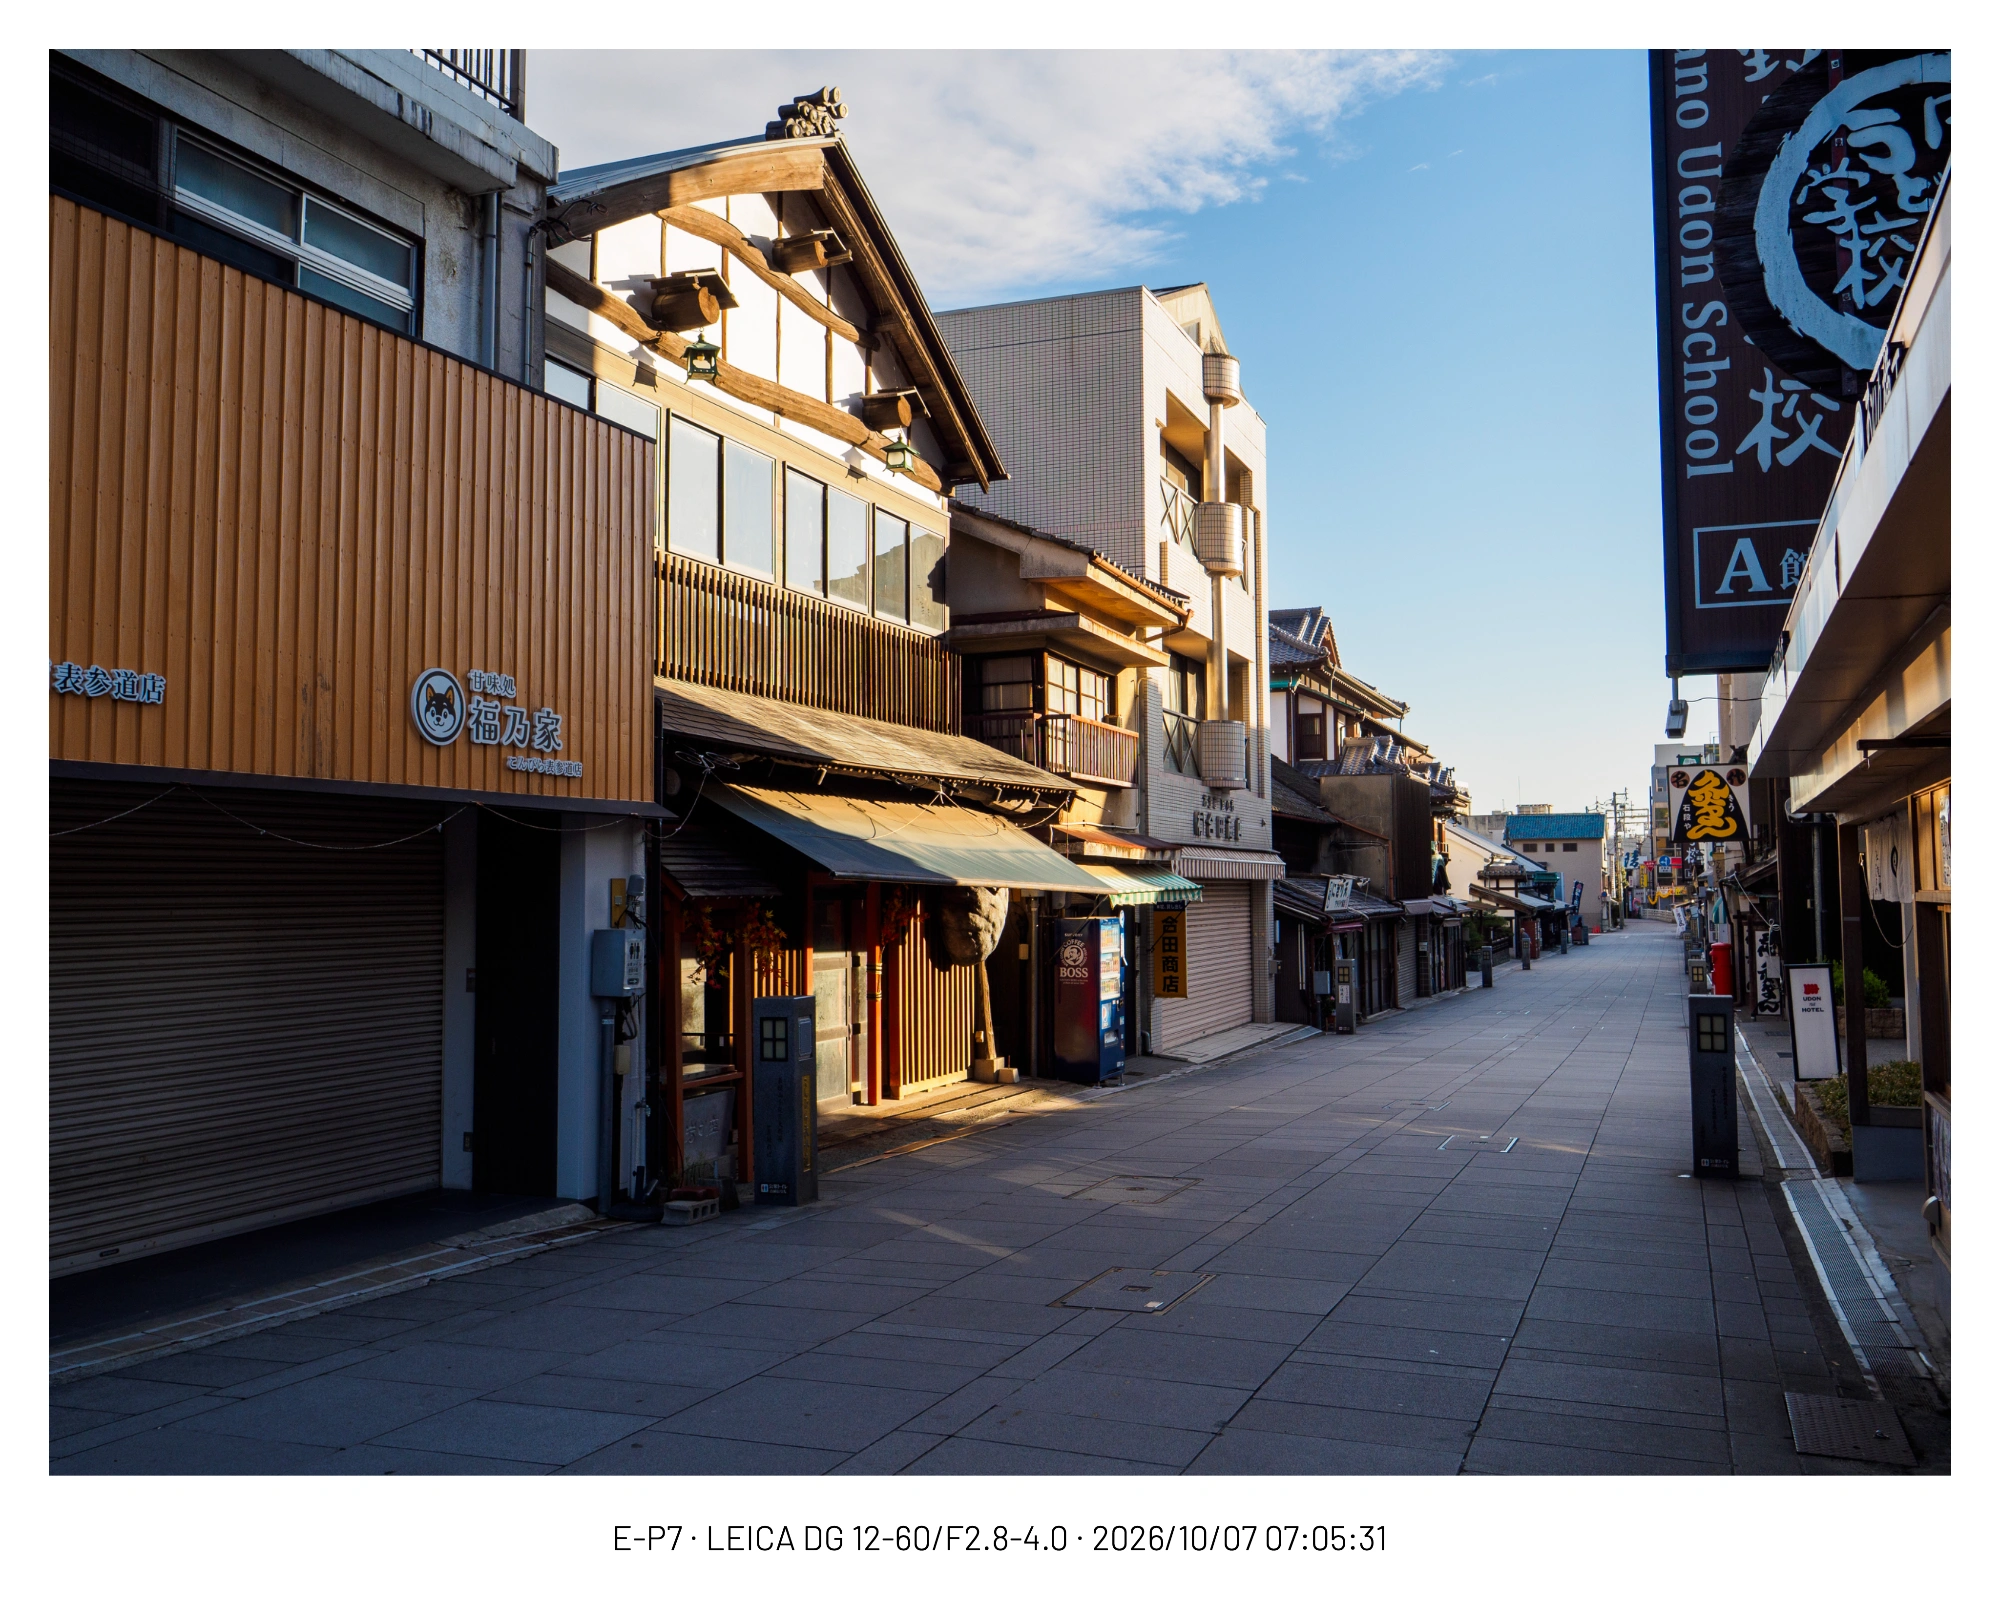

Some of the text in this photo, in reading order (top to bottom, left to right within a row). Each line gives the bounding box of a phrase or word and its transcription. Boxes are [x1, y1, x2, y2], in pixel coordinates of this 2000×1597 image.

[1677, 141, 1722, 288] Udon
[1682, 300, 1734, 479] School
[49, 659, 166, 705] 表参道店
[468, 669, 516, 698] 甘味処
[468, 696, 563, 753] 福乃家
[1683, 804, 1692, 830] 石段や
[1063, 938, 1085, 948] COFFEE
[1162, 916, 1179, 993] 合田商店
[1060, 967, 1088, 978] BOSS
